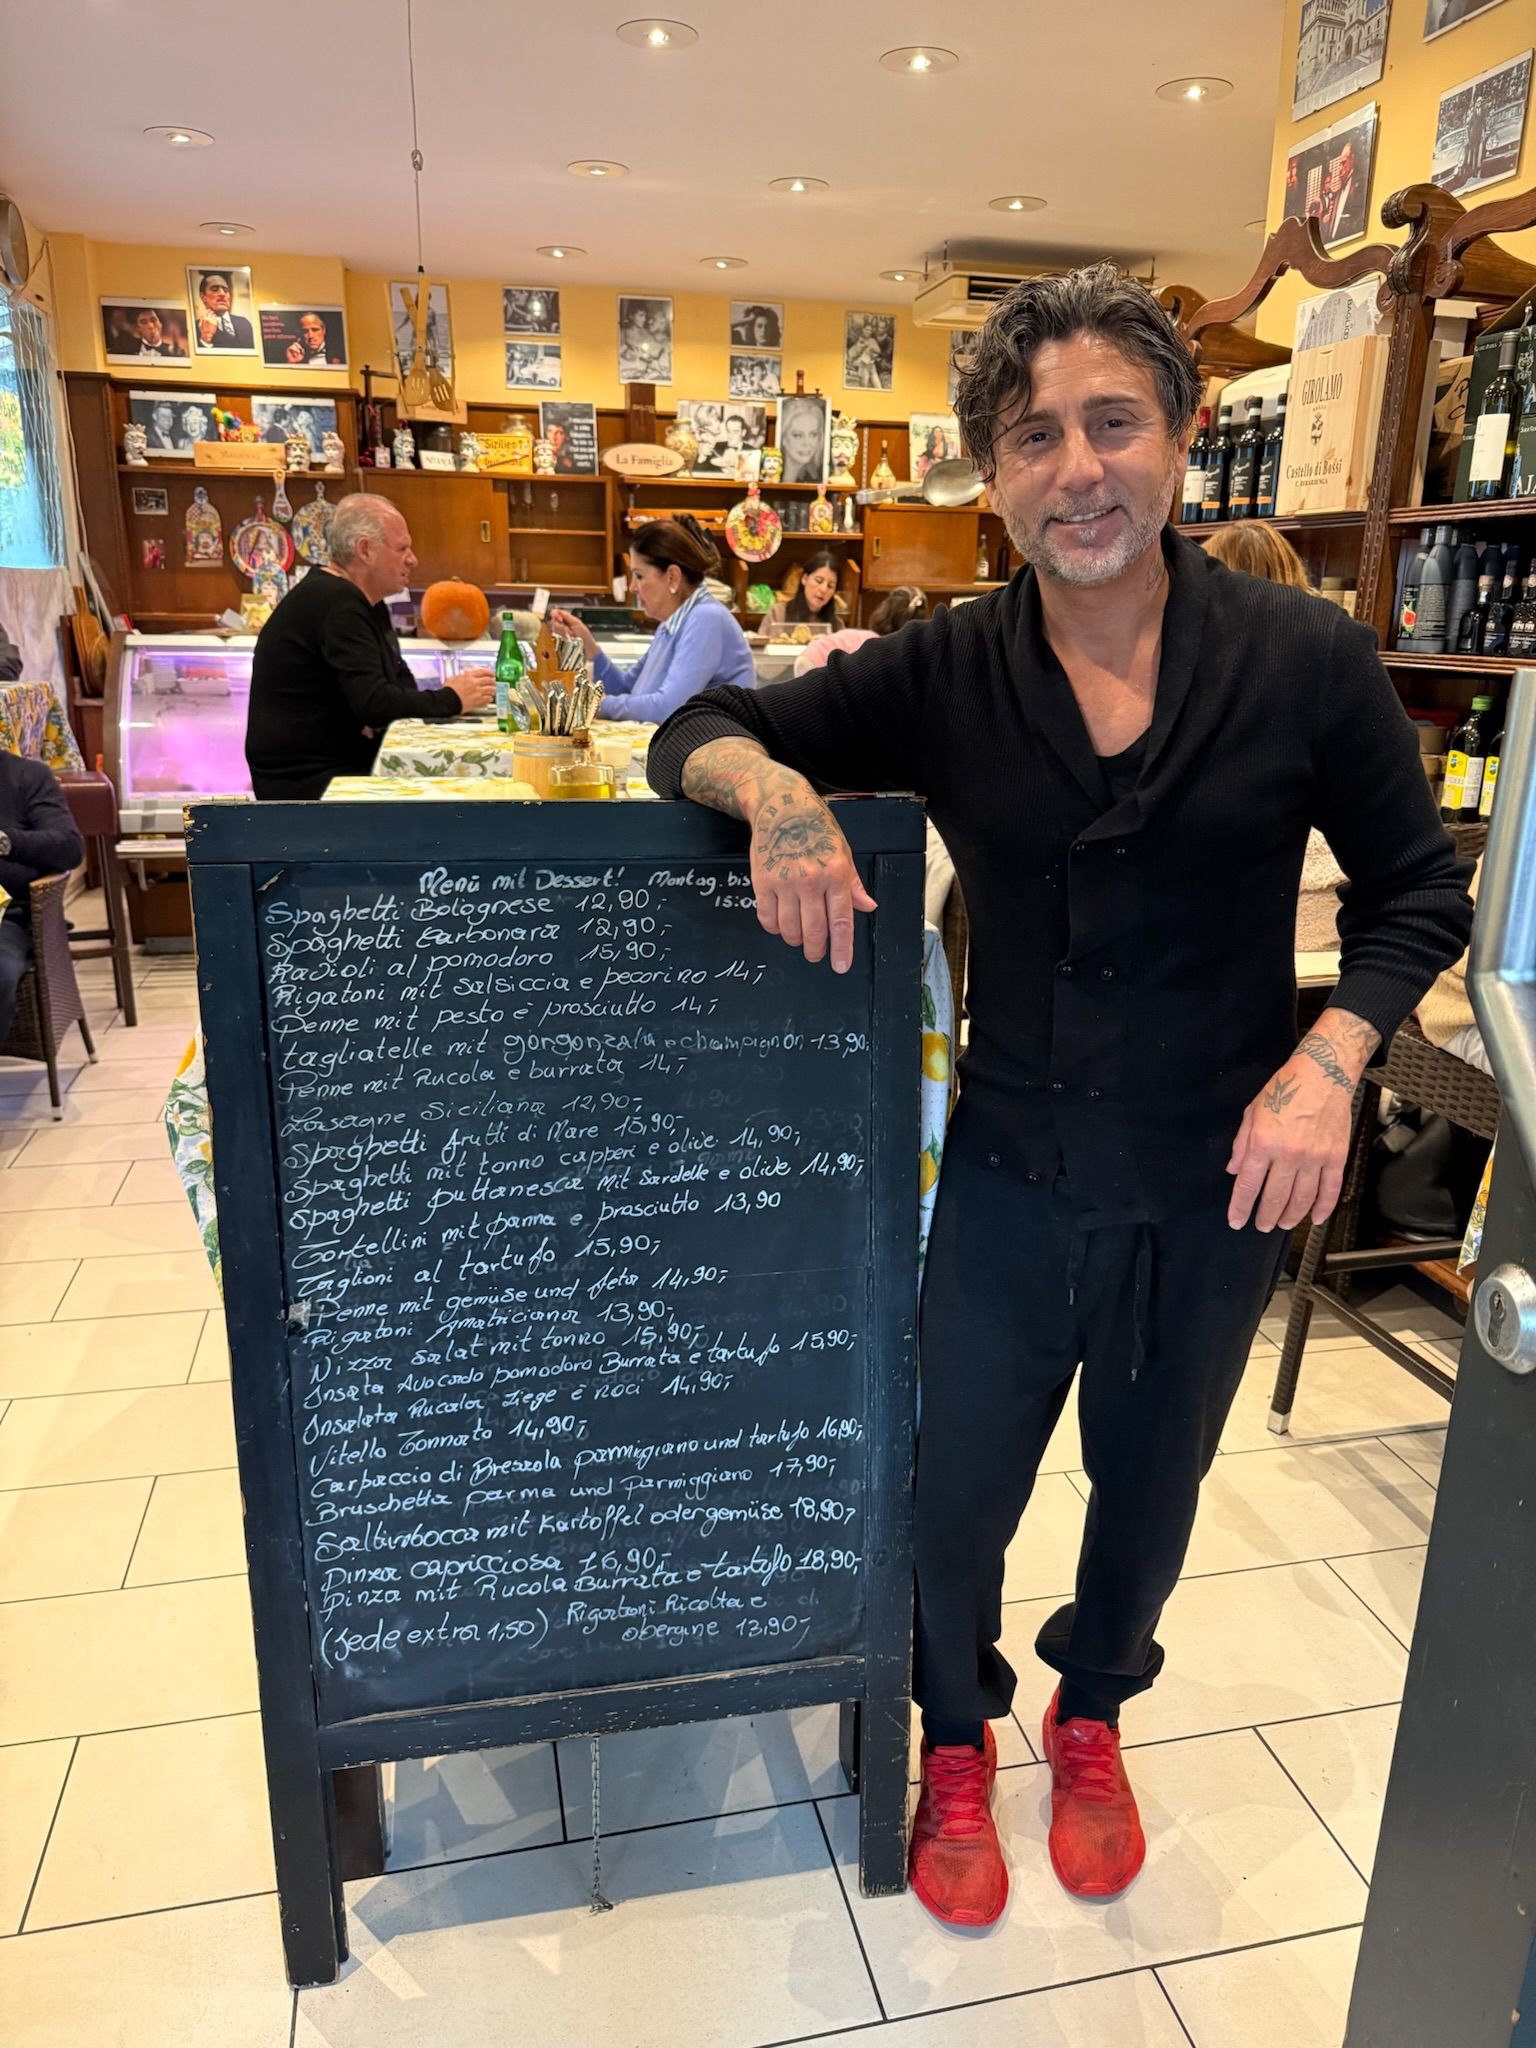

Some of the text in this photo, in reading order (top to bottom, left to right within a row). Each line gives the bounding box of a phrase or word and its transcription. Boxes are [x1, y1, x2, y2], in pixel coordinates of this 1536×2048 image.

[1302, 373, 1343, 406] GIROLAMO
[616, 454, 674, 469] La Famiglia
[1286, 458, 1343, 479] Castello di Bossi
[419, 867, 480, 897] Menü
[492, 867, 526, 890] mit
[536, 866, 624, 891] Dessert!
[727, 870, 751, 887] bis
[265, 894, 405, 937] Spaghetti
[410, 897, 555, 926] Bolognese
[266, 925, 405, 966] Spaghetti
[415, 923, 560, 949] Carbonara
[268, 959, 377, 985] Ravioli
[387, 953, 418, 980] al
[419, 946, 553, 988] pomodoro
[271, 1014, 360, 1043] Penne
[374, 1005, 419, 1031] mit
[431, 999, 504, 1033] pesto
[538, 990, 656, 1027] prosciutto
[272, 980, 385, 1018] Rigatoni
[401, 971, 444, 1002] mit
[580, 977, 594, 991] e
[593, 967, 707, 1000] pecorino
[448, 1029, 489, 1056] mit
[278, 1070, 354, 1103] Penne
[363, 1063, 405, 1093] mit
[412, 1059, 496, 1088] Rucola
[507, 1067, 521, 1081] e
[529, 1050, 625, 1080] burrata
[280, 1106, 407, 1143] Lasagne
[420, 1090, 547, 1121] Siciliana
[284, 1128, 427, 1178] Spaghetti
[440, 1121, 509, 1164] frutti
[517, 1124, 537, 1142] di
[547, 1119, 600, 1143] Mare
[283, 1160, 413, 1208] Spaghetti
[426, 1150, 467, 1181] mit
[479, 1151, 545, 1175] tonno
[559, 1144, 636, 1174] capperi
[648, 1143, 660, 1156] e
[288, 1191, 410, 1240] Spaghetti
[419, 1176, 586, 1226] puttanesca
[718, 1168, 729, 1180] e
[740, 1156, 792, 1180] olive
[291, 1226, 427, 1270] Tortellini
[441, 1210, 482, 1243] mit
[483, 1211, 558, 1250] panna
[569, 1213, 584, 1227] e
[714, 1190, 781, 1214] 13,90
[414, 1258, 443, 1284] al
[459, 1236, 556, 1282] tartufo
[316, 1298, 390, 1327] Penne
[399, 1286, 435, 1315] mit
[439, 1286, 528, 1324] gemüse
[535, 1278, 580, 1300] und
[587, 1266, 640, 1301] feta
[303, 1321, 414, 1354] Rigatoni
[310, 1356, 394, 1384] Nizza
[490, 1326, 532, 1356] mit
[540, 1325, 606, 1350] tonno
[397, 1368, 485, 1394] Avocado
[490, 1350, 593, 1389] pomodoro
[599, 1348, 681, 1375] Burrata
[688, 1351, 702, 1364] e
[707, 1331, 780, 1367] tartufo
[303, 1403, 399, 1446] Insalata
[594, 1378, 645, 1400] noci
[310, 1438, 387, 1478] Vitello
[398, 1417, 493, 1457] Tonnato
[310, 1467, 432, 1499] Carpaccio
[439, 1459, 464, 1484] di
[703, 1429, 744, 1451] und
[749, 1419, 810, 1452] tartufo
[305, 1489, 453, 1527] Bruschetta
[570, 1476, 613, 1497] und
[314, 1520, 480, 1562] Saltimbocca
[486, 1509, 531, 1540] mit
[538, 1503, 645, 1541] Kartoffel
[415, 1579, 461, 1603] mit
[473, 1574, 568, 1600] Rucola
[574, 1564, 682, 1592] Burrata
[687, 1568, 702, 1582] e
[407, 1611, 481, 1643] extra
[488, 1607, 548, 1650] 1,50)
[566, 1594, 656, 1634] Rigatoni
[751, 1594, 768, 1609] e
[622, 1619, 720, 1647] obergine
